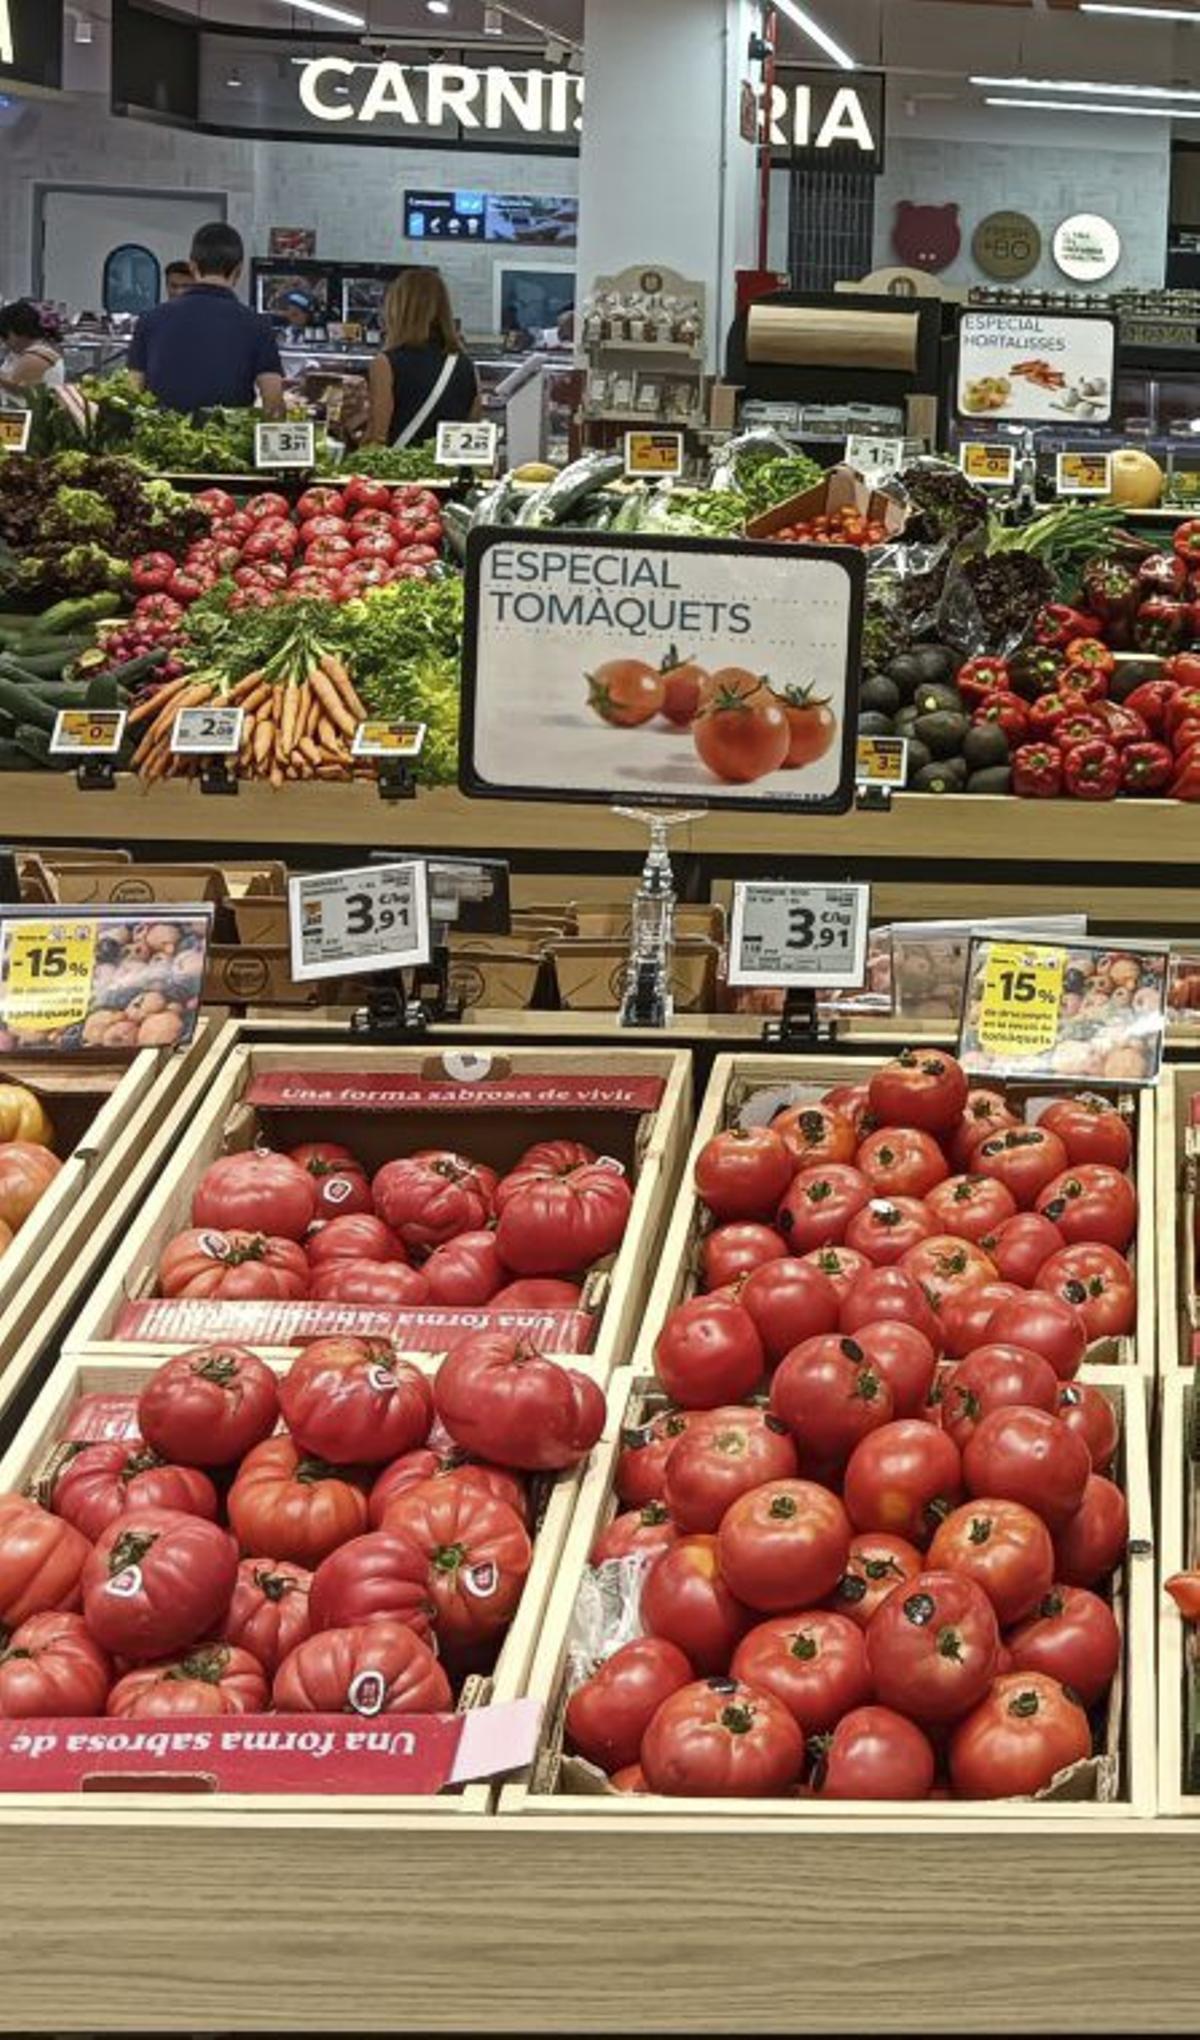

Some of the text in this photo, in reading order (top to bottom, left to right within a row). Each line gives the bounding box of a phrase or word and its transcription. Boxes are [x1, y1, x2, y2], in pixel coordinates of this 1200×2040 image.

[965, 315, 1044, 332] ESPECIAL
[964, 334, 1066, 351] HORTALISSES
[490, 549, 681, 590] ESPECIAL
[489, 588, 752, 636] TOMÀQUETS
[281, 1086, 635, 1101] Una forma sabrosa de vivir
[10, 1731, 416, 1759] Una forma sabrosa de
